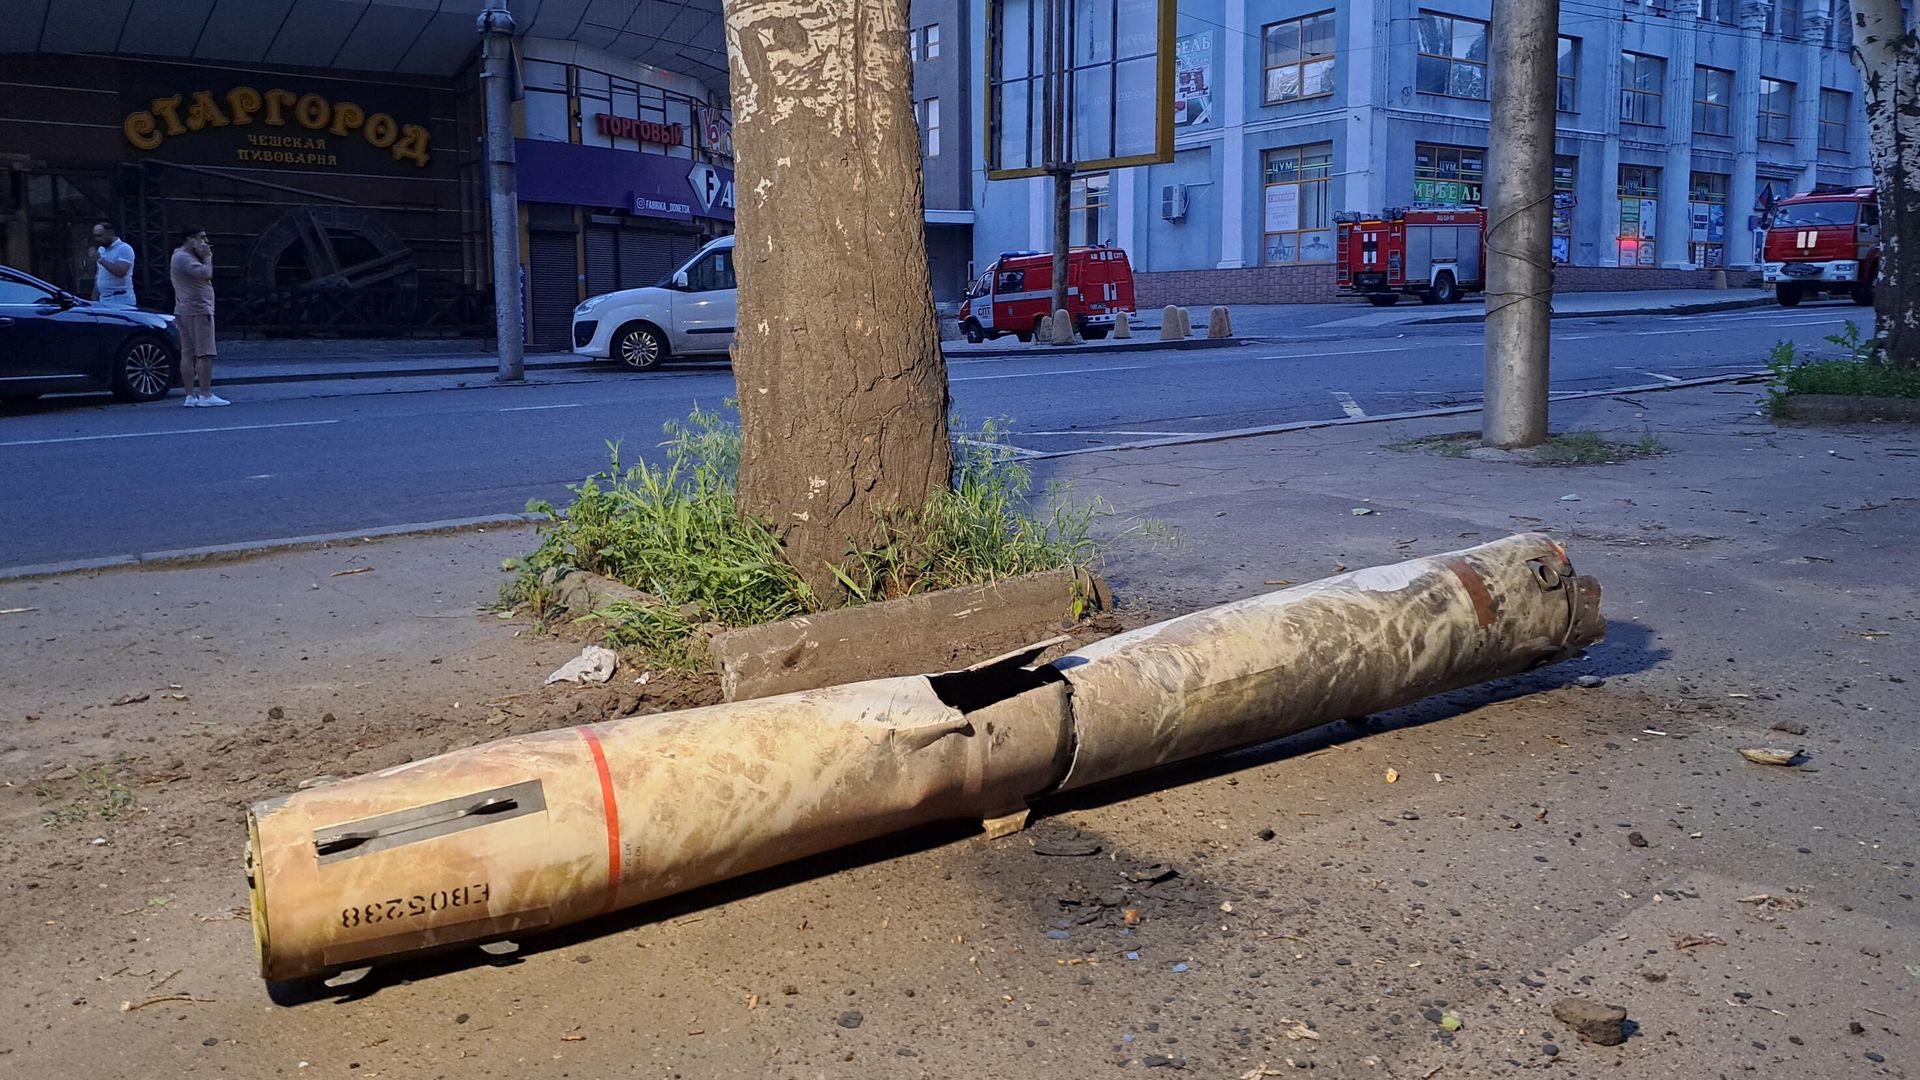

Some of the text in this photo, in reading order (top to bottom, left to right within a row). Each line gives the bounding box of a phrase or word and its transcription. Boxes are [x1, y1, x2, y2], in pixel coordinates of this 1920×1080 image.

[123, 86, 432, 167] СТАРГОРОД
[596, 113, 684, 145] ТОРГОВЫЙ
[247, 134, 327, 150] ЧЕШСКАЯ
[237, 149, 337, 166] ПИВОВАРНЯ
[1272, 160, 1293, 173] ЦУМ
[1439, 162, 1457, 173] ЦУМ
[1414, 183, 1481, 201] МЕБЕЛЬ
[341, 882, 491, 929] EB05238
